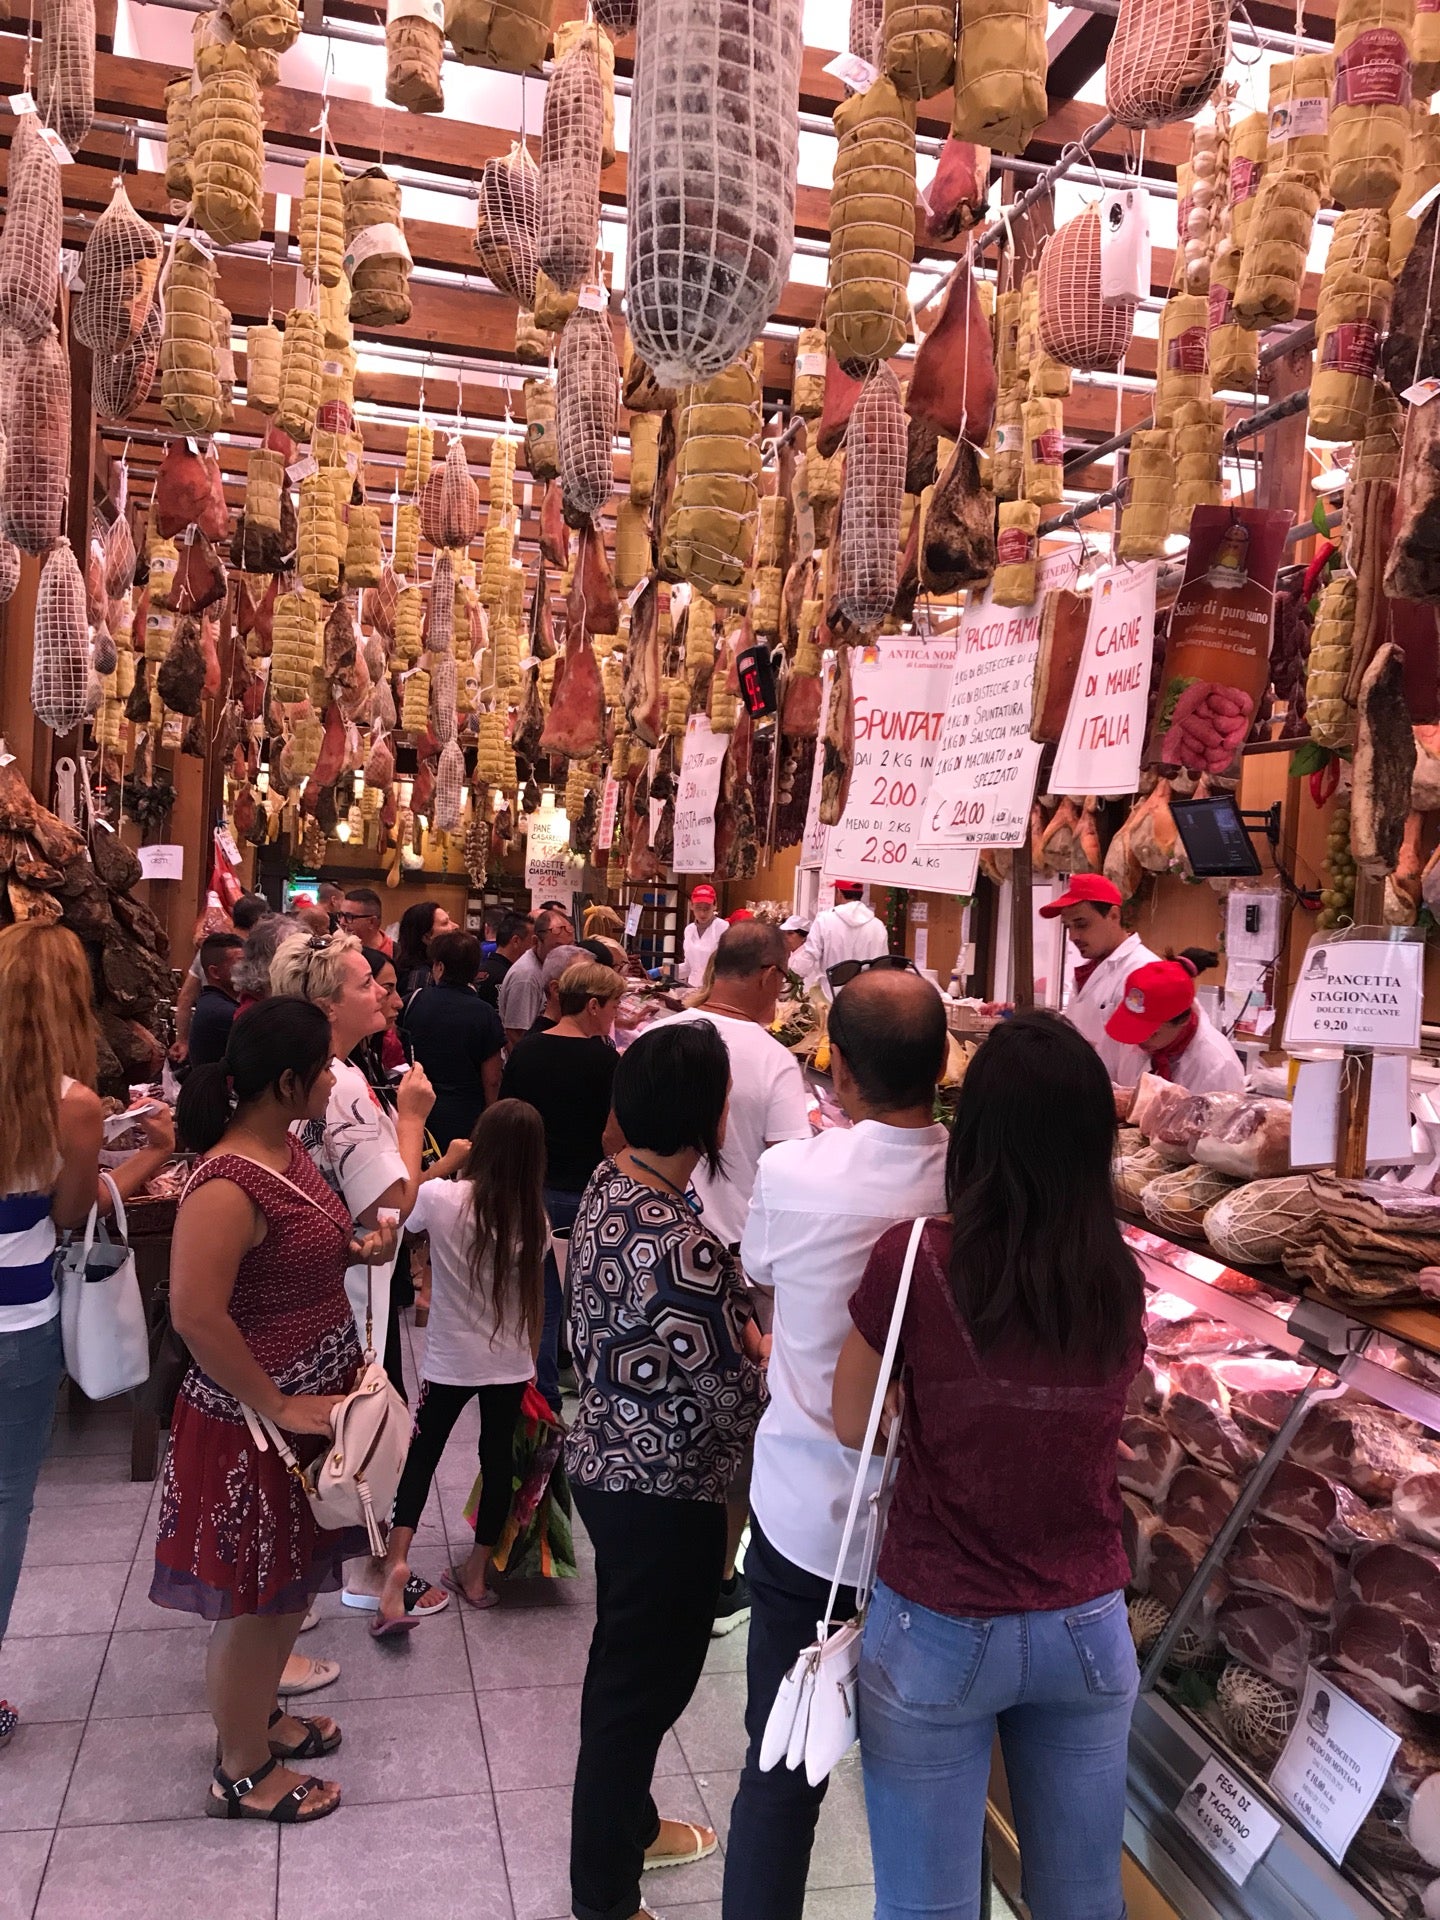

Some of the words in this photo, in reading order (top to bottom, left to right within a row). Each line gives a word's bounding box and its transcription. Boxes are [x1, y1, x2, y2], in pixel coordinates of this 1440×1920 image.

[1363, 56, 1396, 66] Lonza
[1202, 600, 1218, 615] di
[1220, 606, 1246, 621] puro
[1246, 607, 1269, 625] suino
[1095, 616, 1142, 657] CARNE
[888, 649, 930, 660] ANTICA
[1084, 674, 1099, 698] DI
[1105, 662, 1143, 696] MAIALE
[854, 696, 945, 741] SPUNTAT
[1078, 713, 1130, 750] ITALIA
[854, 751, 872, 767] DAI
[880, 750, 890, 767] 2
[893, 752, 913, 768] KG
[972, 766, 1019, 789] SPEZZATO
[870, 776, 917, 807] 2,00
[533, 824, 552, 834] PANE
[845, 818, 870, 830] MENO
[873, 821, 883, 831] DI
[835, 839, 846, 860] €
[861, 836, 908, 864] 2,80
[911, 856, 923, 867] AL
[926, 856, 941, 869] KG
[528, 867, 567, 878] CIABATTINE
[530, 859, 565, 870] ROSETTE
[1326, 975, 1402, 988] PANCETTA
[1309, 991, 1399, 1005] STAGIONATA
[1316, 1006, 1345, 1014] DOLCE
[1354, 1008, 1401, 1017] PICCANTE
[1313, 1019, 1321, 1030] €
[1323, 1019, 1348, 1031] 9,20
[1306, 1735, 1326, 1758] CRUDO
[1331, 1759, 1362, 1794] MONTAGNA
[1325, 1737, 1361, 1775] PROSCIUTTO
[1305, 1768, 1313, 1778] €
[1215, 1773, 1239, 1800] FESA
[1237, 1796, 1252, 1813] DI
[1197, 1807, 1205, 1817] €
[1207, 1790, 1251, 1839] TACCHINO
